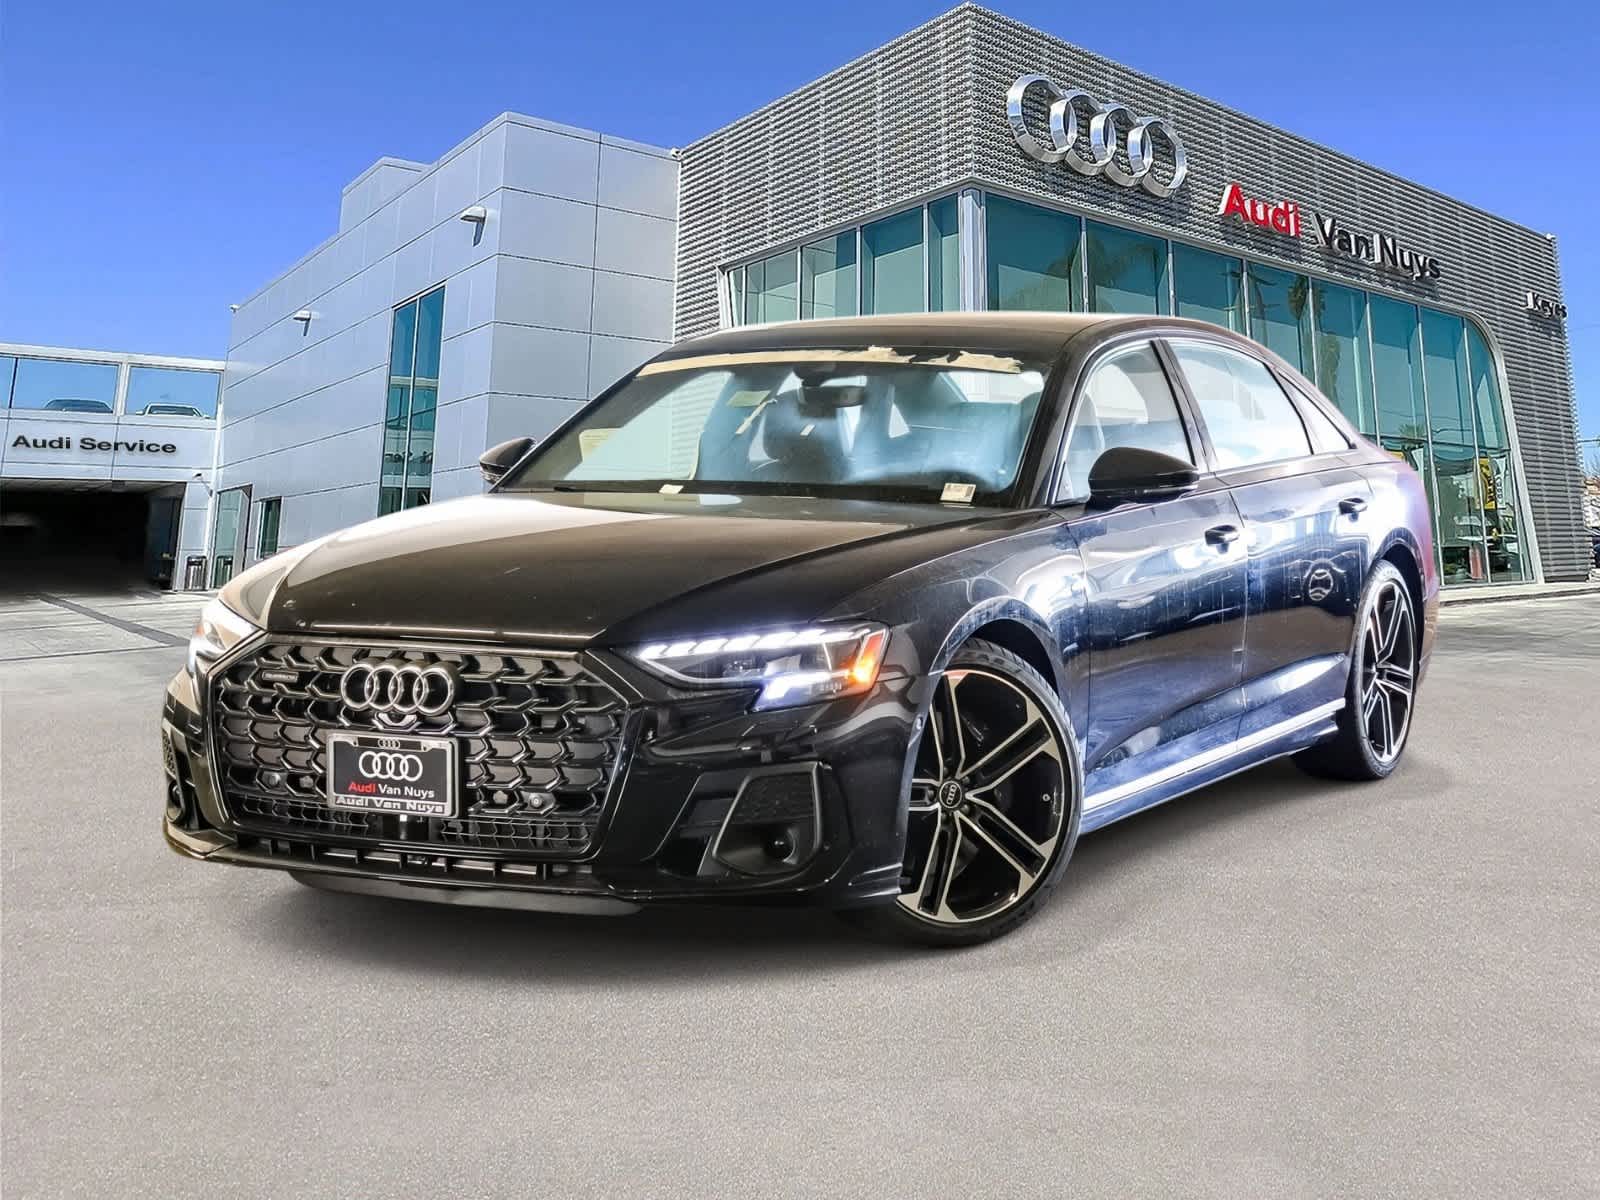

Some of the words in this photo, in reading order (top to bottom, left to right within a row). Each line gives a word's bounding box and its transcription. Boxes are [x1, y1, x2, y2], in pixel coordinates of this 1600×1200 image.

[1217, 183, 1302, 238] Audi
[1311, 212, 1371, 259] Van
[1374, 233, 1440, 280] Nuys
[1527, 292, 1567, 318] Keyes
[12, 435, 71, 449] Audi
[79, 437, 177, 453] Service
[348, 781, 376, 793] Audi
[378, 783, 401, 795] Van
[404, 786, 435, 799] Nuys
[336, 796, 369, 807] Audi
[374, 798, 401, 810] Van
